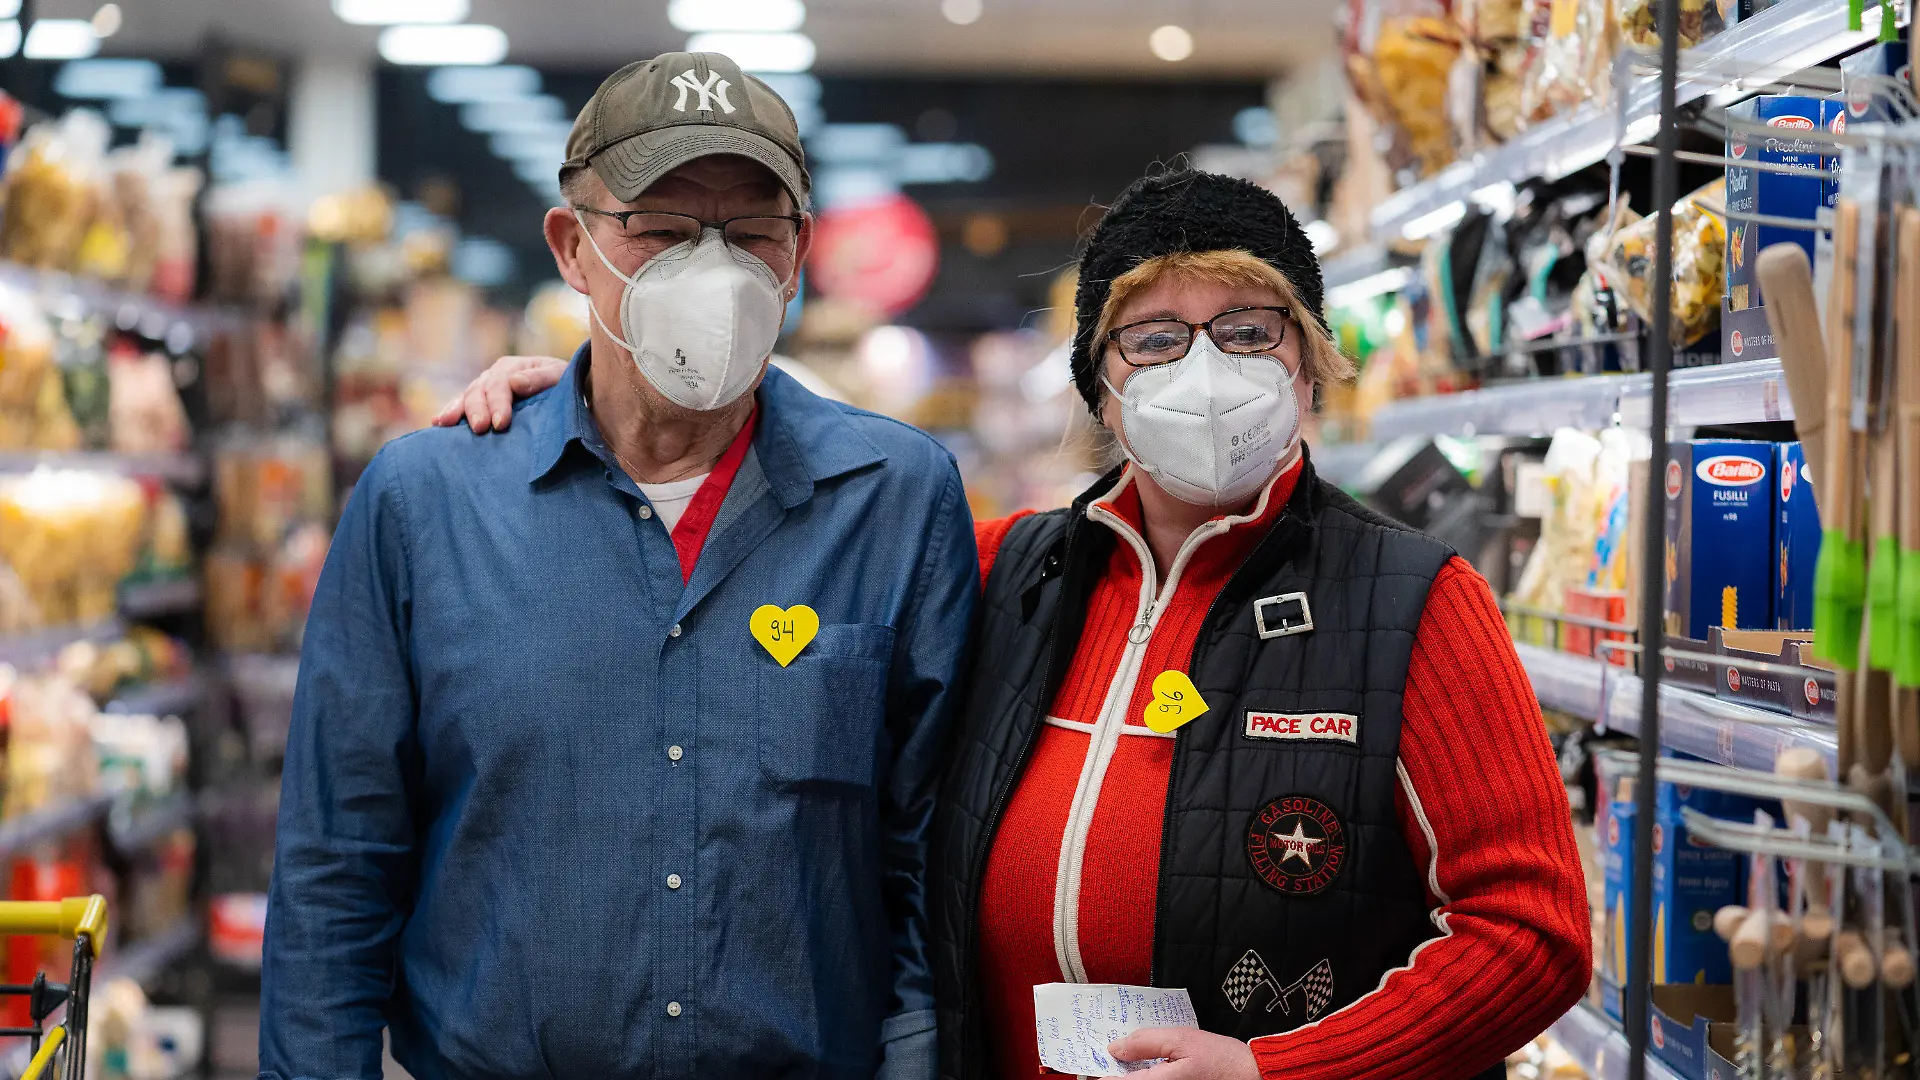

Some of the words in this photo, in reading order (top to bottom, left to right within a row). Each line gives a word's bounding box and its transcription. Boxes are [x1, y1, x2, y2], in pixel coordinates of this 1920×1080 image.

[670, 69, 736, 114] NY
[1777, 119, 1810, 129] Barilla
[1764, 138, 1815, 153] Piccolini
[1782, 155, 1799, 163] MINI
[1711, 462, 1760, 478] Barilla
[1713, 489, 1748, 502] FUSILLI
[771, 620, 794, 643] 94
[1741, 675, 1760, 689] MASTERS
[1760, 678, 1767, 689] OF
[1767, 680, 1781, 693] PASTA
[1159, 691, 1184, 715] 96
[1251, 716, 1302, 734] PACE
[1309, 716, 1352, 736] CAR
[1261, 799, 1338, 833] GASOLINE
[1269, 838, 1304, 853] MOTOR
[1305, 842, 1325, 854] OILS
[1251, 833, 1289, 887] FILLING
[1294, 844, 1344, 893] STATION
